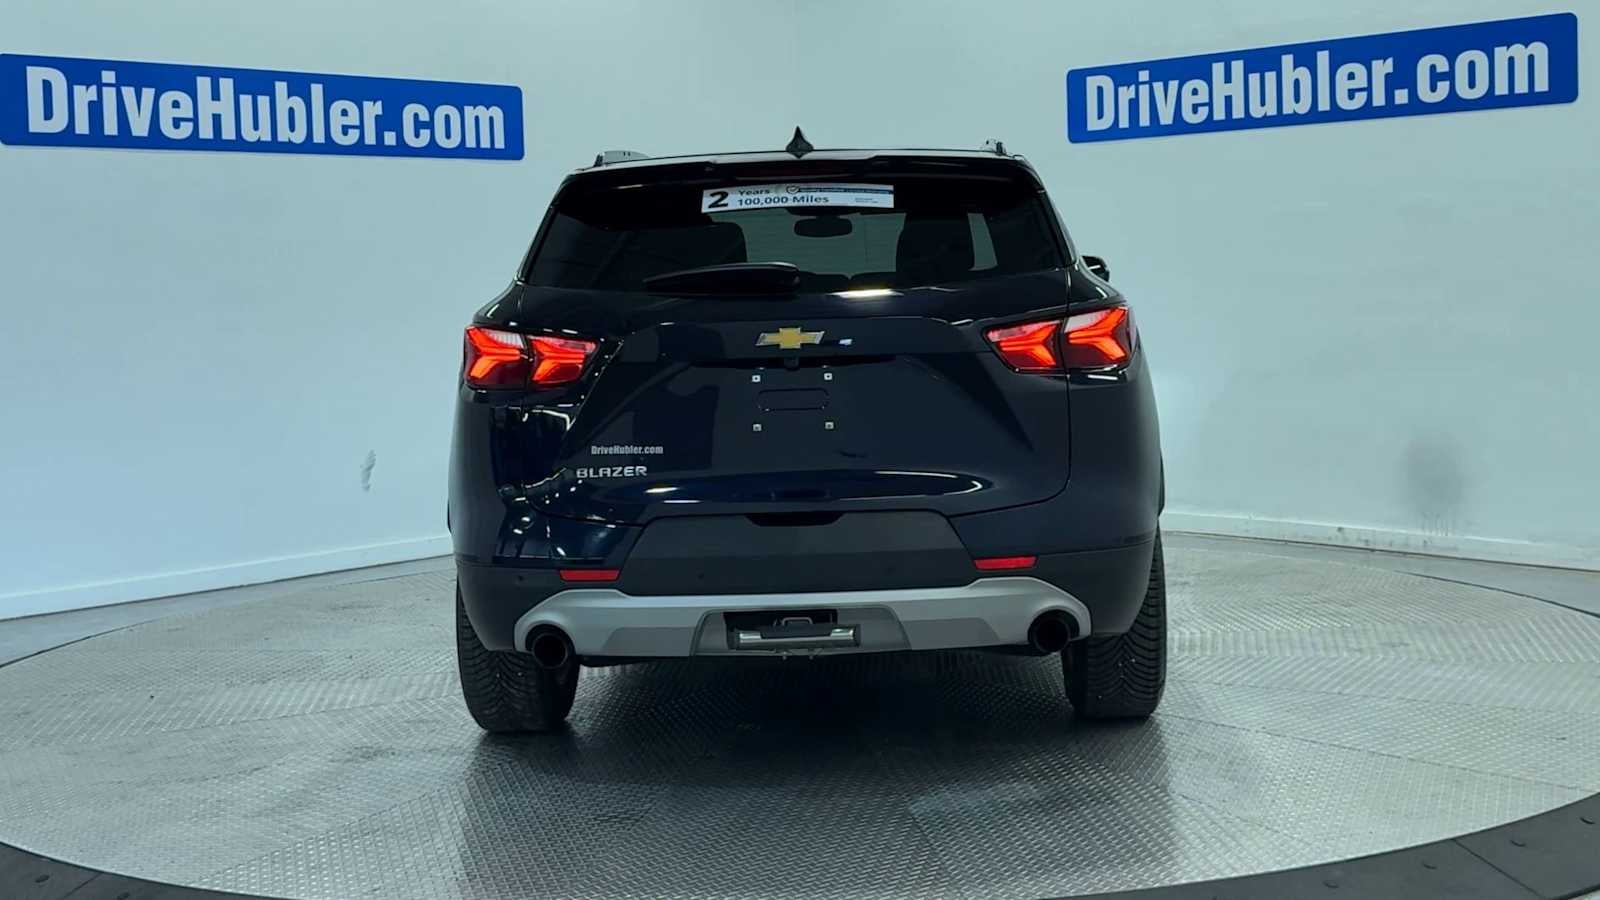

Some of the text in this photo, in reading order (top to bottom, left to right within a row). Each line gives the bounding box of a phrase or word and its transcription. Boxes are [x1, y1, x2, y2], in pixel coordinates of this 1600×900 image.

[1085, 40, 1549, 131] DriveHubler.com
[26, 65, 505, 150] DriveHubler.com
[738, 188, 770, 196] Years
[708, 191, 729, 209] 2
[738, 195, 829, 206] 100,000 Miles
[591, 445, 664, 455] DriveHubler.com
[576, 466, 648, 478] BLAZER
